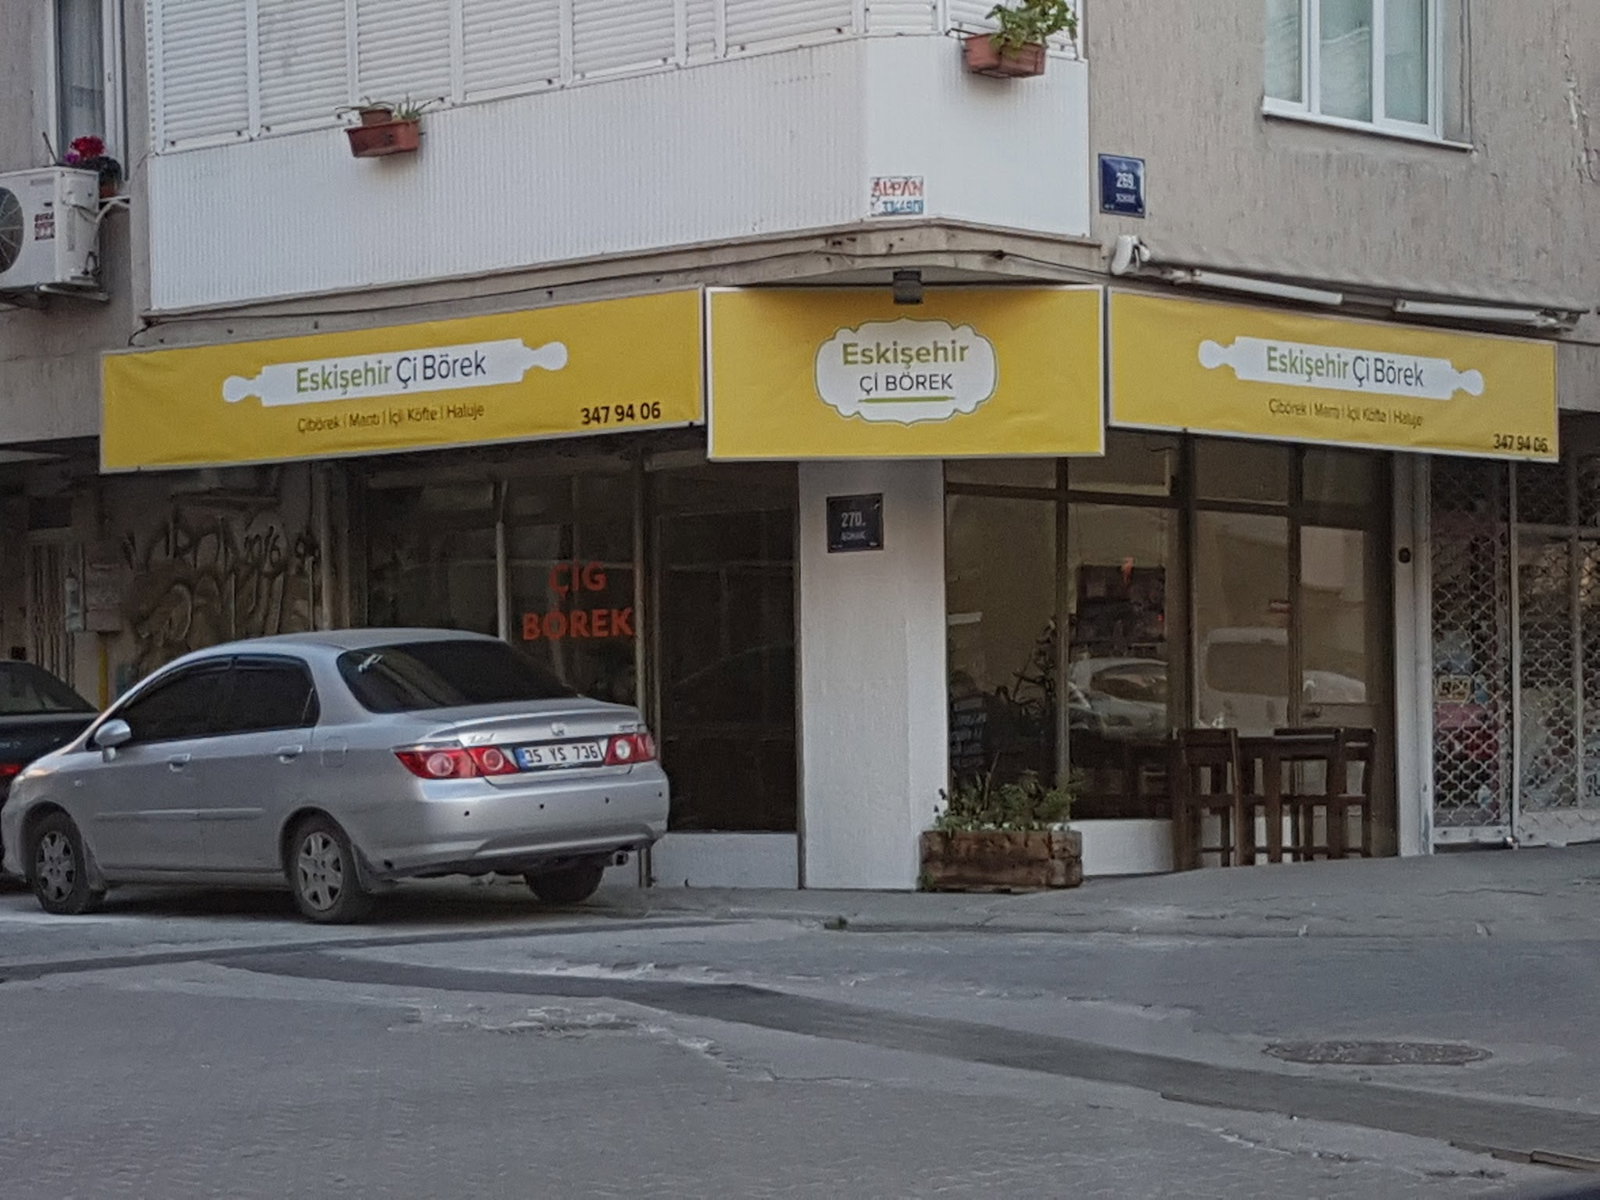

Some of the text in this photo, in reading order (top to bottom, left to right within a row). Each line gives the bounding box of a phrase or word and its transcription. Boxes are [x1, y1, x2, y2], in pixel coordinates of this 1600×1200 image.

[842, 339, 970, 370] Eskişehir
[1266, 345, 1425, 388] Eskişehir Çi Börek
[296, 349, 487, 396] Eskişehir Çi Börek
[885, 371, 954, 392] BÖREK
[580, 401, 662, 425] 347 94 06
[1493, 433, 1549, 453] 347 94 06
[548, 746, 567, 762] YS
